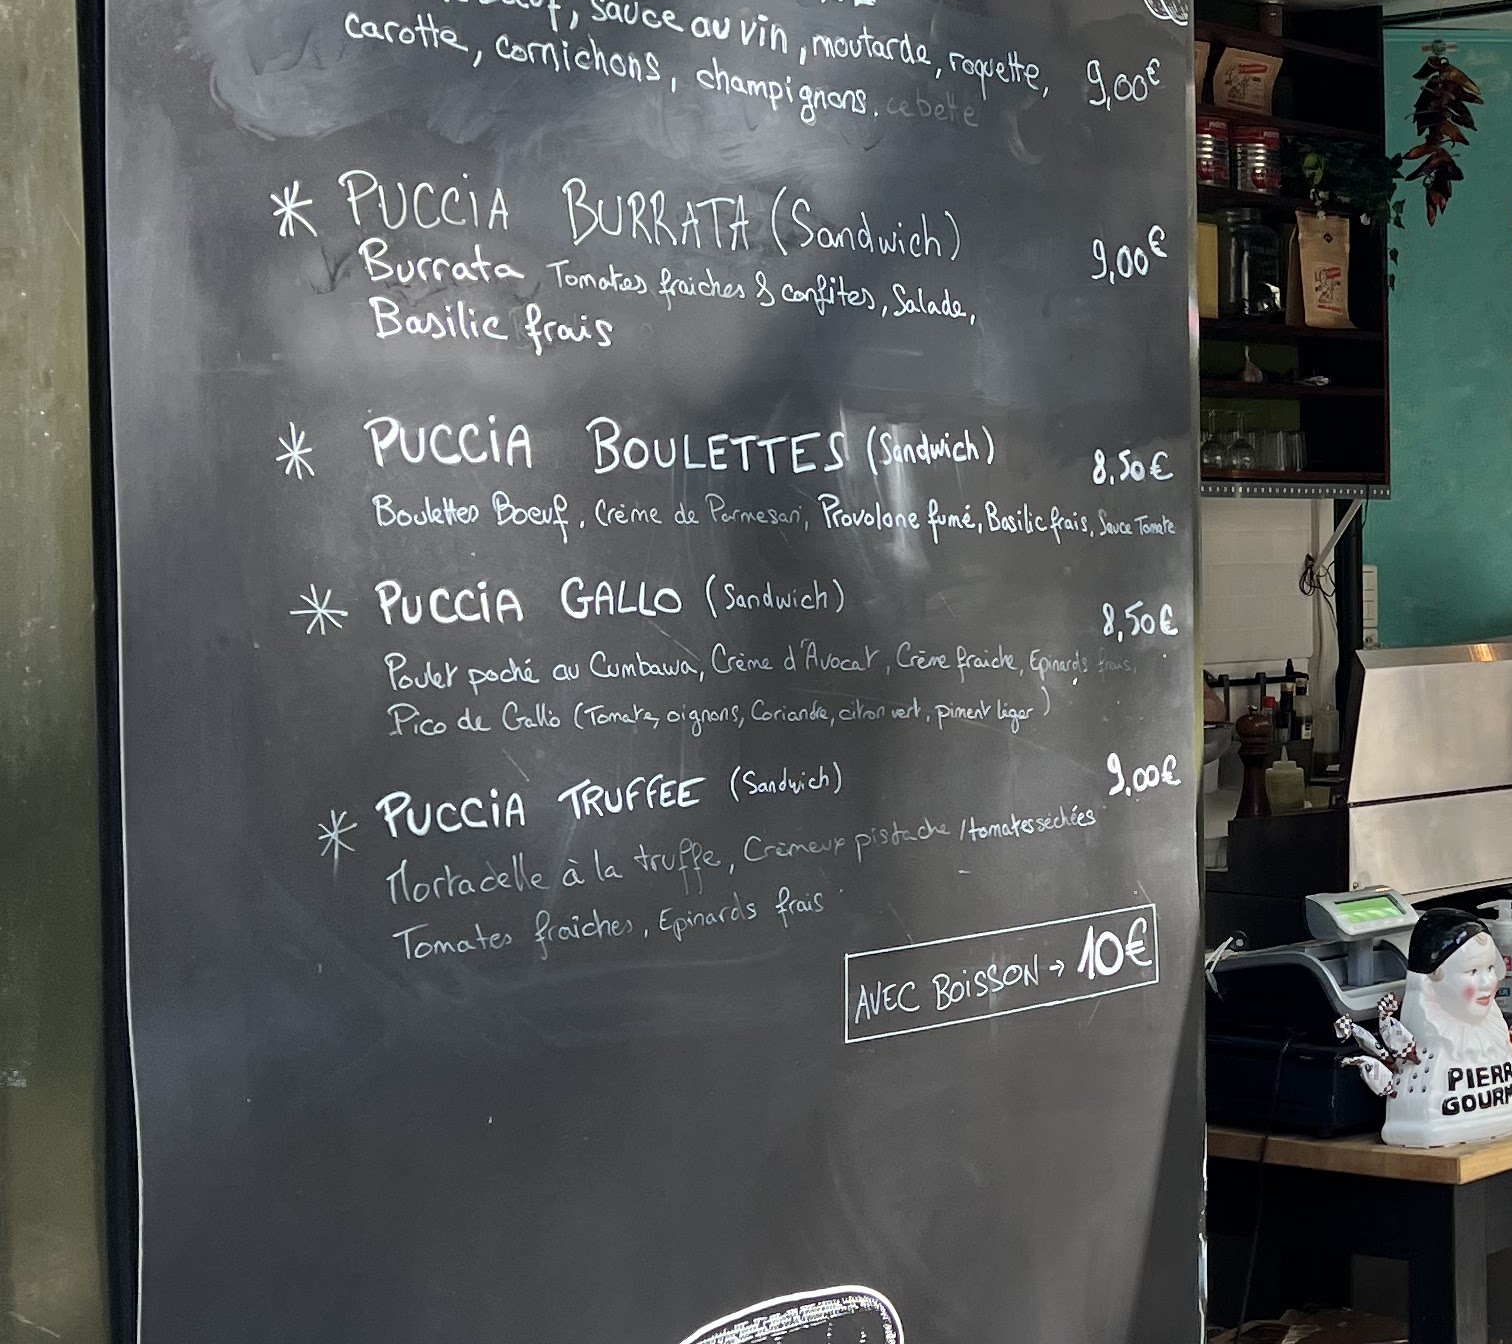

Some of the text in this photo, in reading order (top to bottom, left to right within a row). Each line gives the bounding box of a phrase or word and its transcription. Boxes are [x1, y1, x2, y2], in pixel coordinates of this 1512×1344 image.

[690, 16, 731, 40] au
[1086, 58, 1162, 112] 9,00€
[561, 177, 750, 252] BURRATA
[770, 185, 961, 261] (Sandwich)
[357, 237, 526, 284] Burrata
[545, 259, 649, 295] Tomates
[1090, 224, 1168, 284] 9,00€
[367, 295, 614, 356] Basilic frais
[585, 416, 846, 474] BOULETTES
[866, 425, 996, 476] (Sandwich)
[1091, 449, 1175, 486] 8,50€
[372, 493, 481, 528] Boulettes
[674, 502, 700, 526] de
[817, 493, 920, 532] Provolone
[984, 500, 1049, 535] Basilic
[1098, 508, 1133, 537] Sauce
[1134, 514, 1177, 537] Tomate
[559, 575, 684, 621] GALLO
[704, 573, 847, 619] (Sandwich)
[1101, 600, 1180, 642] 8,50€
[384, 651, 459, 691] Poulet
[467, 657, 540, 696] poché
[552, 663, 580, 682] au
[386, 702, 447, 737] Pico
[457, 706, 491, 732] de
[501, 701, 562, 731] Gallo
[838, 699, 886, 721] citron
[934, 700, 992, 731] piment
[557, 773, 707, 821] TRUFFEE
[730, 761, 843, 802] (Sandwich)
[1106, 751, 1182, 796] 9,00€
[385, 851, 552, 905] Mortadelle
[562, 859, 585, 887] à
[594, 848, 624, 882] la
[853, 816, 951, 864] pistache
[392, 922, 513, 961] Tomates
[658, 891, 758, 942] Epinards
[774, 886, 825, 928] frais
[854, 916, 1154, 1025] AVEC BOISSON 10€
